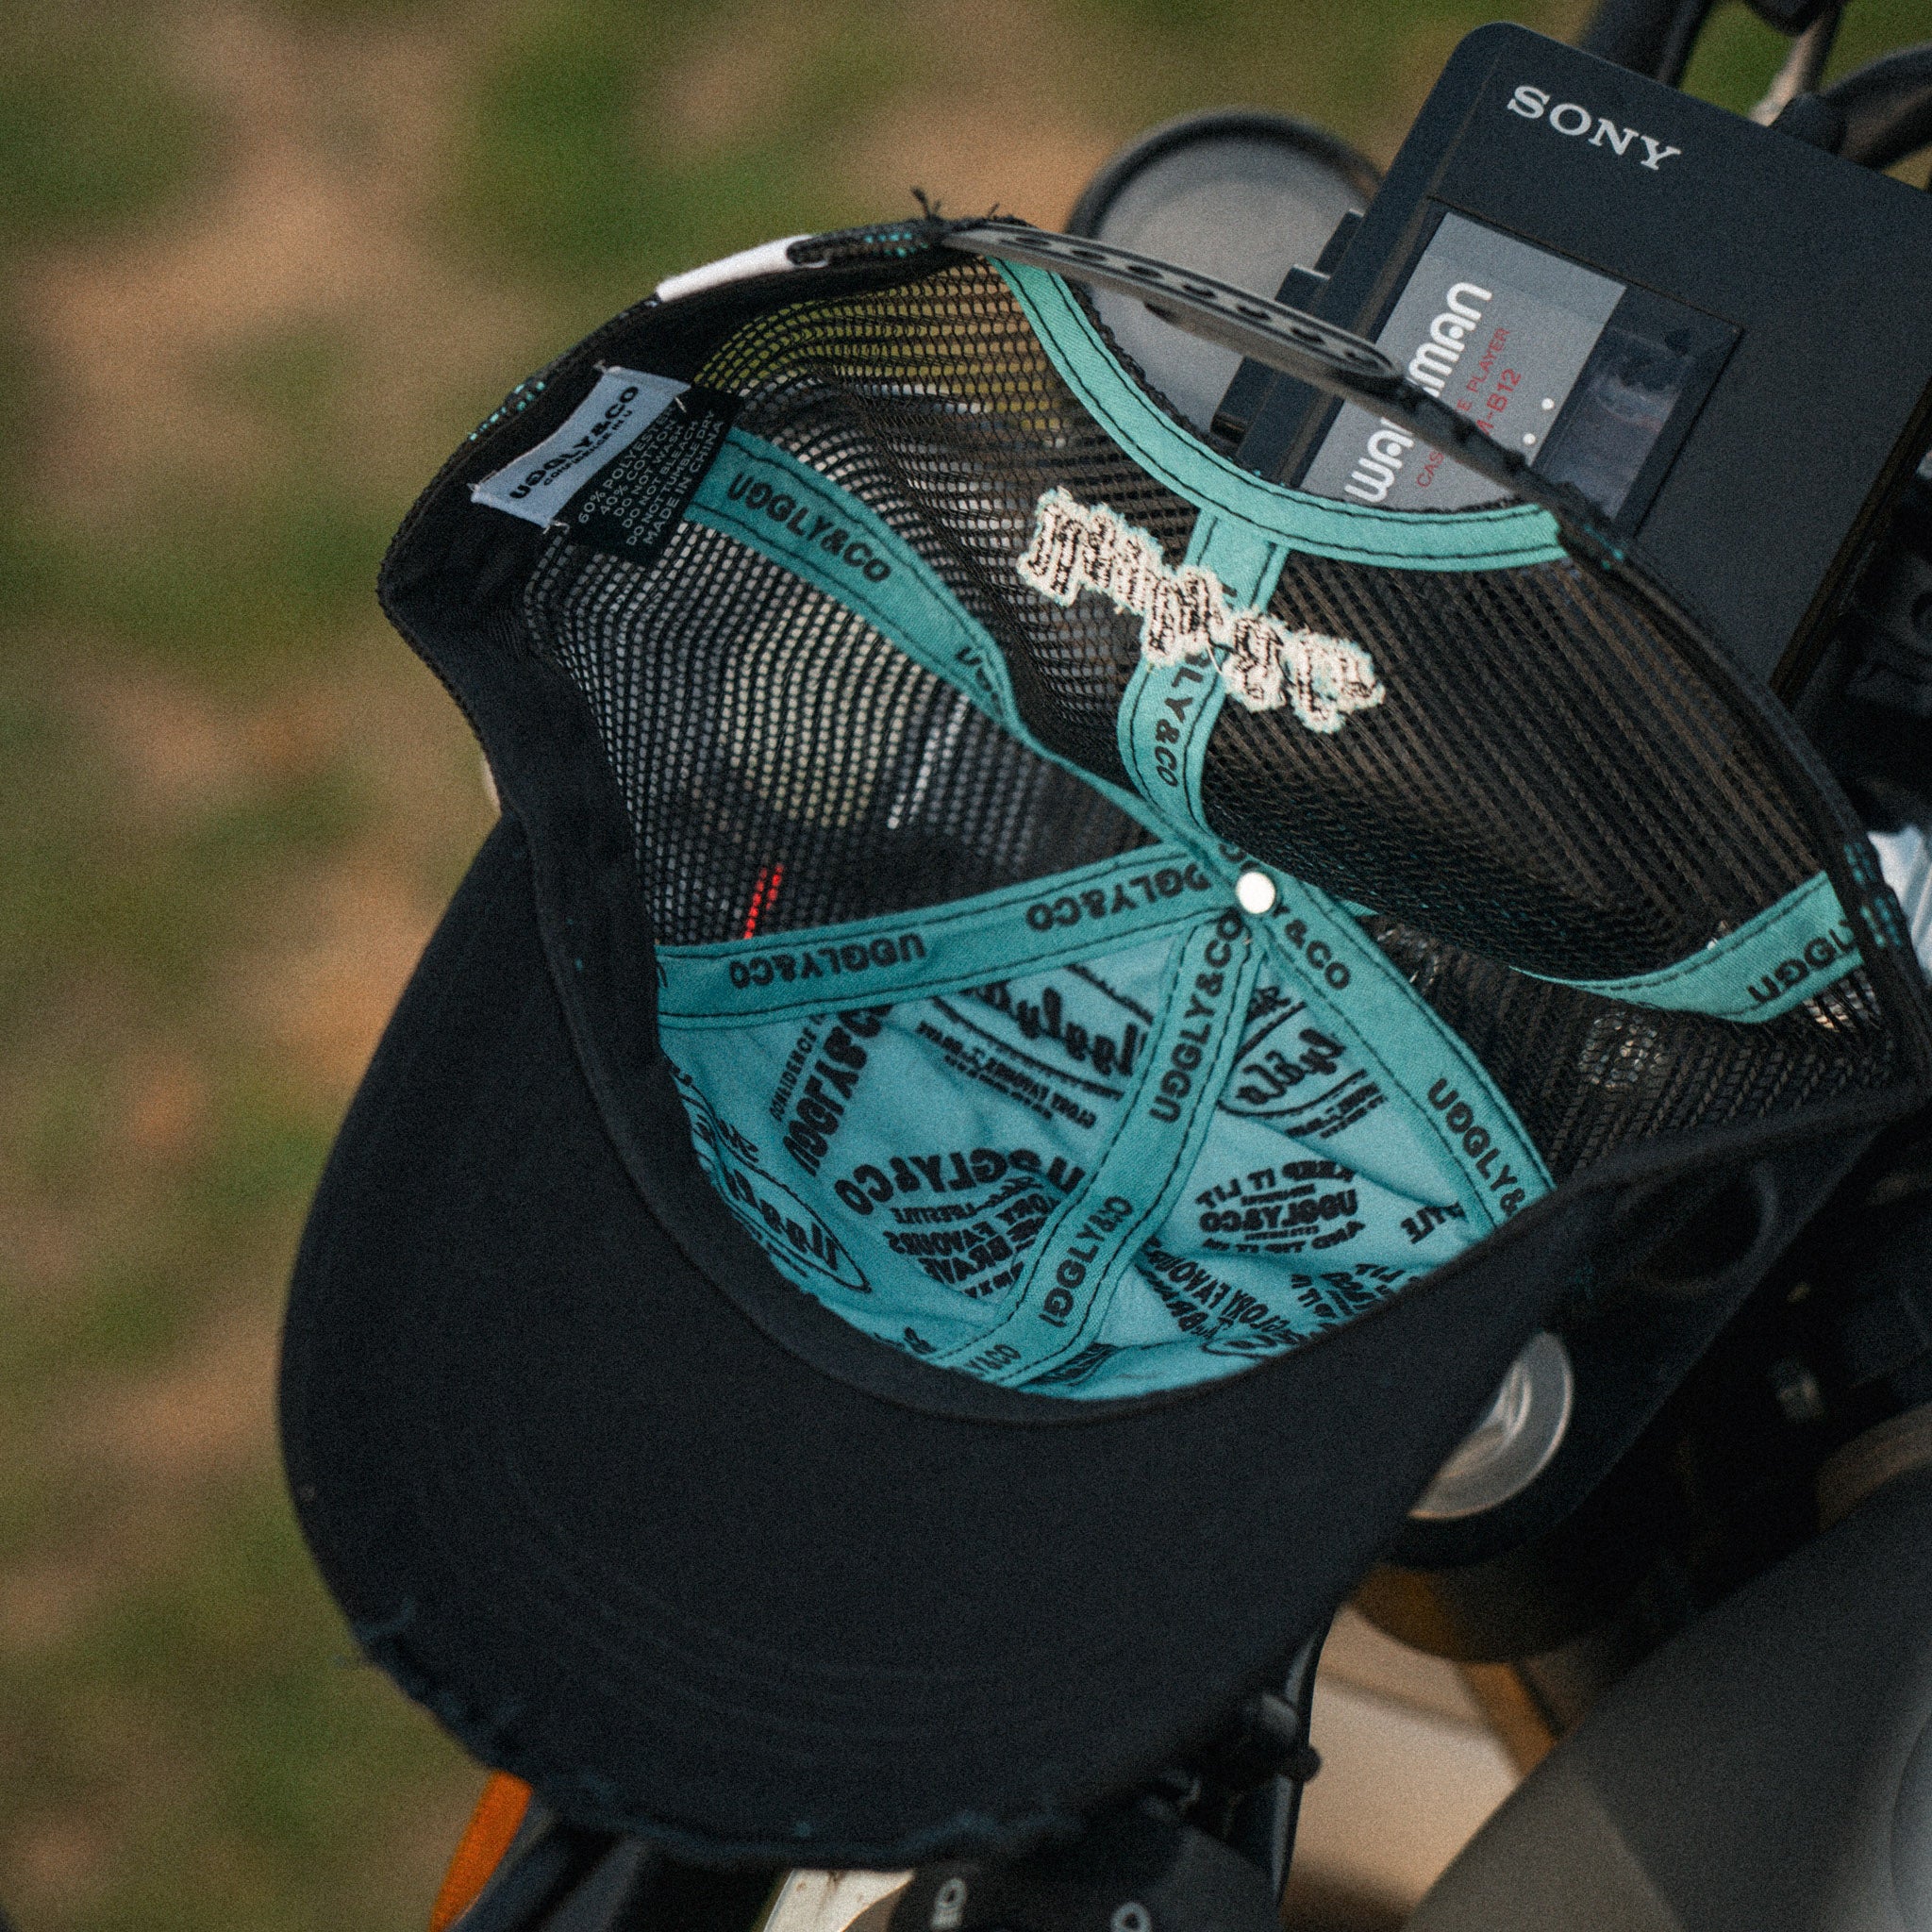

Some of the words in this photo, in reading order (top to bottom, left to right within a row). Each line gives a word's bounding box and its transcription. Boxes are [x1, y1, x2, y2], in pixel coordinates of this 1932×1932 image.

[1507, 85, 1682, 171] SONY
[1343, 281, 1492, 503] WAMAN
[1466, 325, 1511, 393] PLAYER
[1478, 367, 1522, 435] M-B12
[577, 490, 607, 525] 60%
[602, 404, 675, 490] POLYESTER
[599, 483, 629, 515] 40%
[625, 419, 676, 482] COTTON
[612, 496, 633, 518] DO
[630, 466, 654, 495] NOT
[652, 425, 684, 464] WASH
[621, 507, 641, 529] DO
[638, 476, 661, 507] NOT
[658, 421, 699, 475] BLEACH
[625, 525, 645, 546] DO
[641, 494, 664, 525] NOT
[659, 441, 699, 494] TUMBLE
[695, 410, 715, 440] DRY
[642, 496, 680, 545] MADE
[675, 476, 692, 494] IN
[689, 422, 724, 474] CHINA
